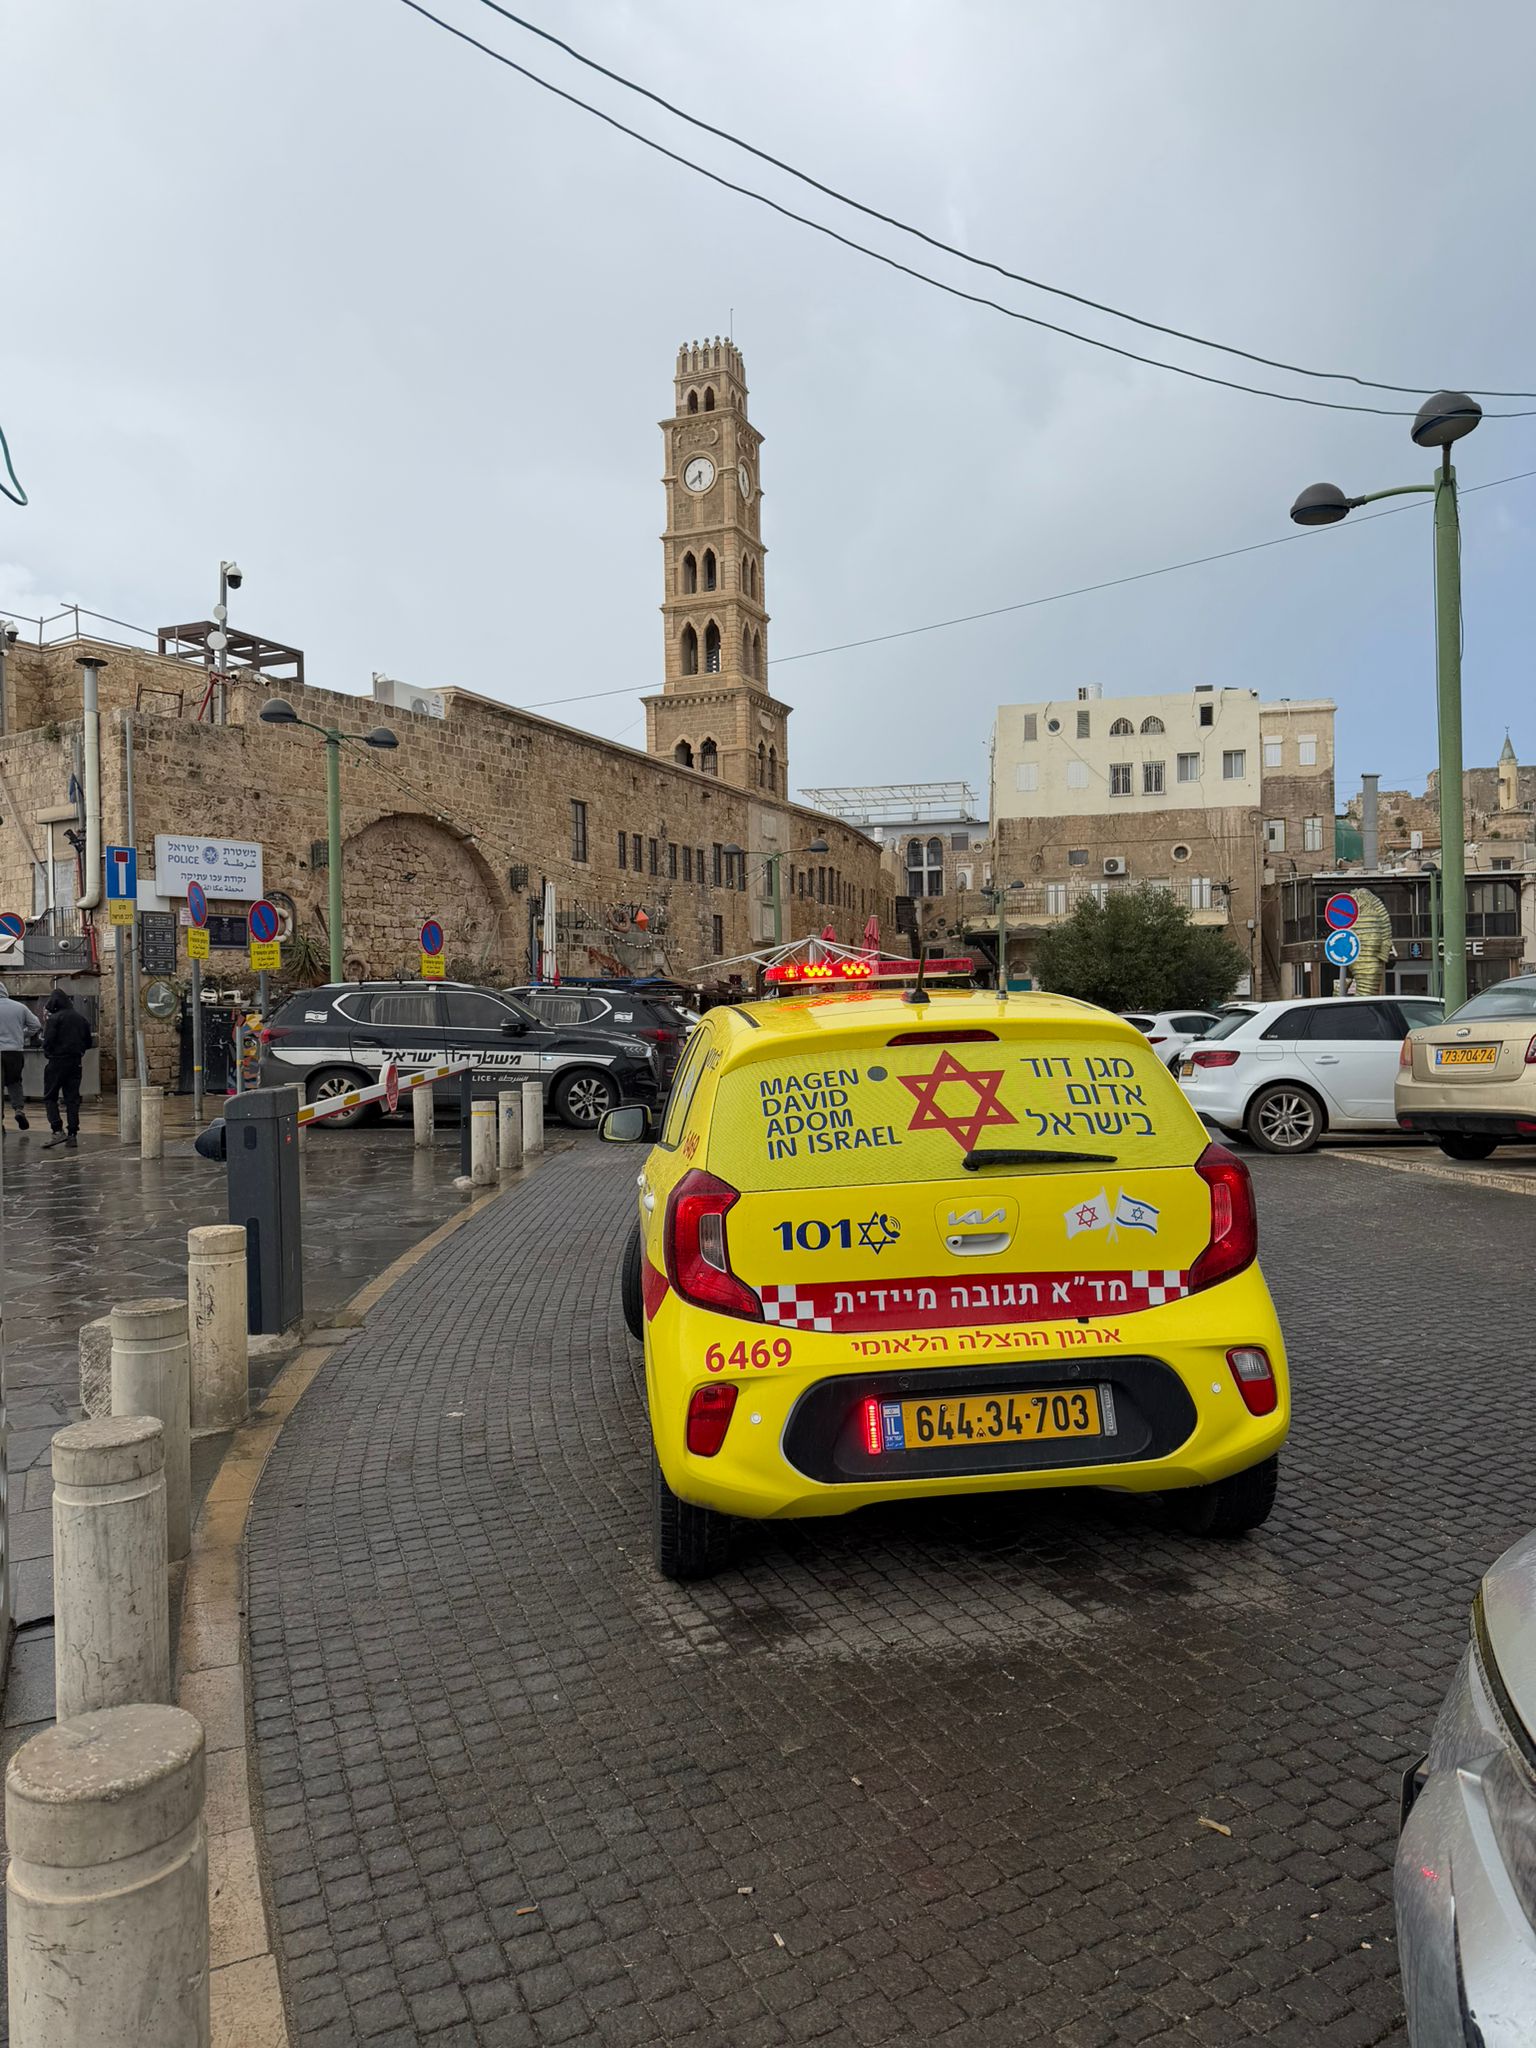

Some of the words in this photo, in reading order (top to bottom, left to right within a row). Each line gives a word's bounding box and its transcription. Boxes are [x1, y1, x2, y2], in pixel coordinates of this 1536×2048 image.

[168, 841, 199, 852] ישראל
[223, 847, 257, 857] משטרת
[168, 855, 200, 865] POLICE
[180, 872, 208, 882] עתיקה
[209, 873, 222, 882] עכו
[224, 875, 247, 884] נקודת
[382, 1050, 437, 1063] ישראל
[1020, 1057, 1073, 1078] דוד
[1084, 1057, 1135, 1082] מגן
[760, 1068, 860, 1098] MAGEN
[762, 1089, 849, 1117] DAVID
[1066, 1084, 1147, 1106] אדום
[766, 1108, 854, 1139] ADOM
[1025, 1108, 1157, 1137] בישראל
[768, 1136, 798, 1161] IN
[808, 1125, 903, 1154] ISRAEL
[948, 1208, 1006, 1226] KIA
[773, 1218, 852, 1251] 101
[833, 1287, 937, 1314] מיידית
[951, 1282, 1039, 1309] תגובה
[1052, 1275, 1128, 1304] מד"א
[851, 1334, 949, 1356] הלאומי
[958, 1330, 1050, 1350] ההצלה
[1055, 1328, 1123, 1349] ארגון
[705, 1337, 792, 1373] 6469
[886, 1417, 900, 1435] IL
